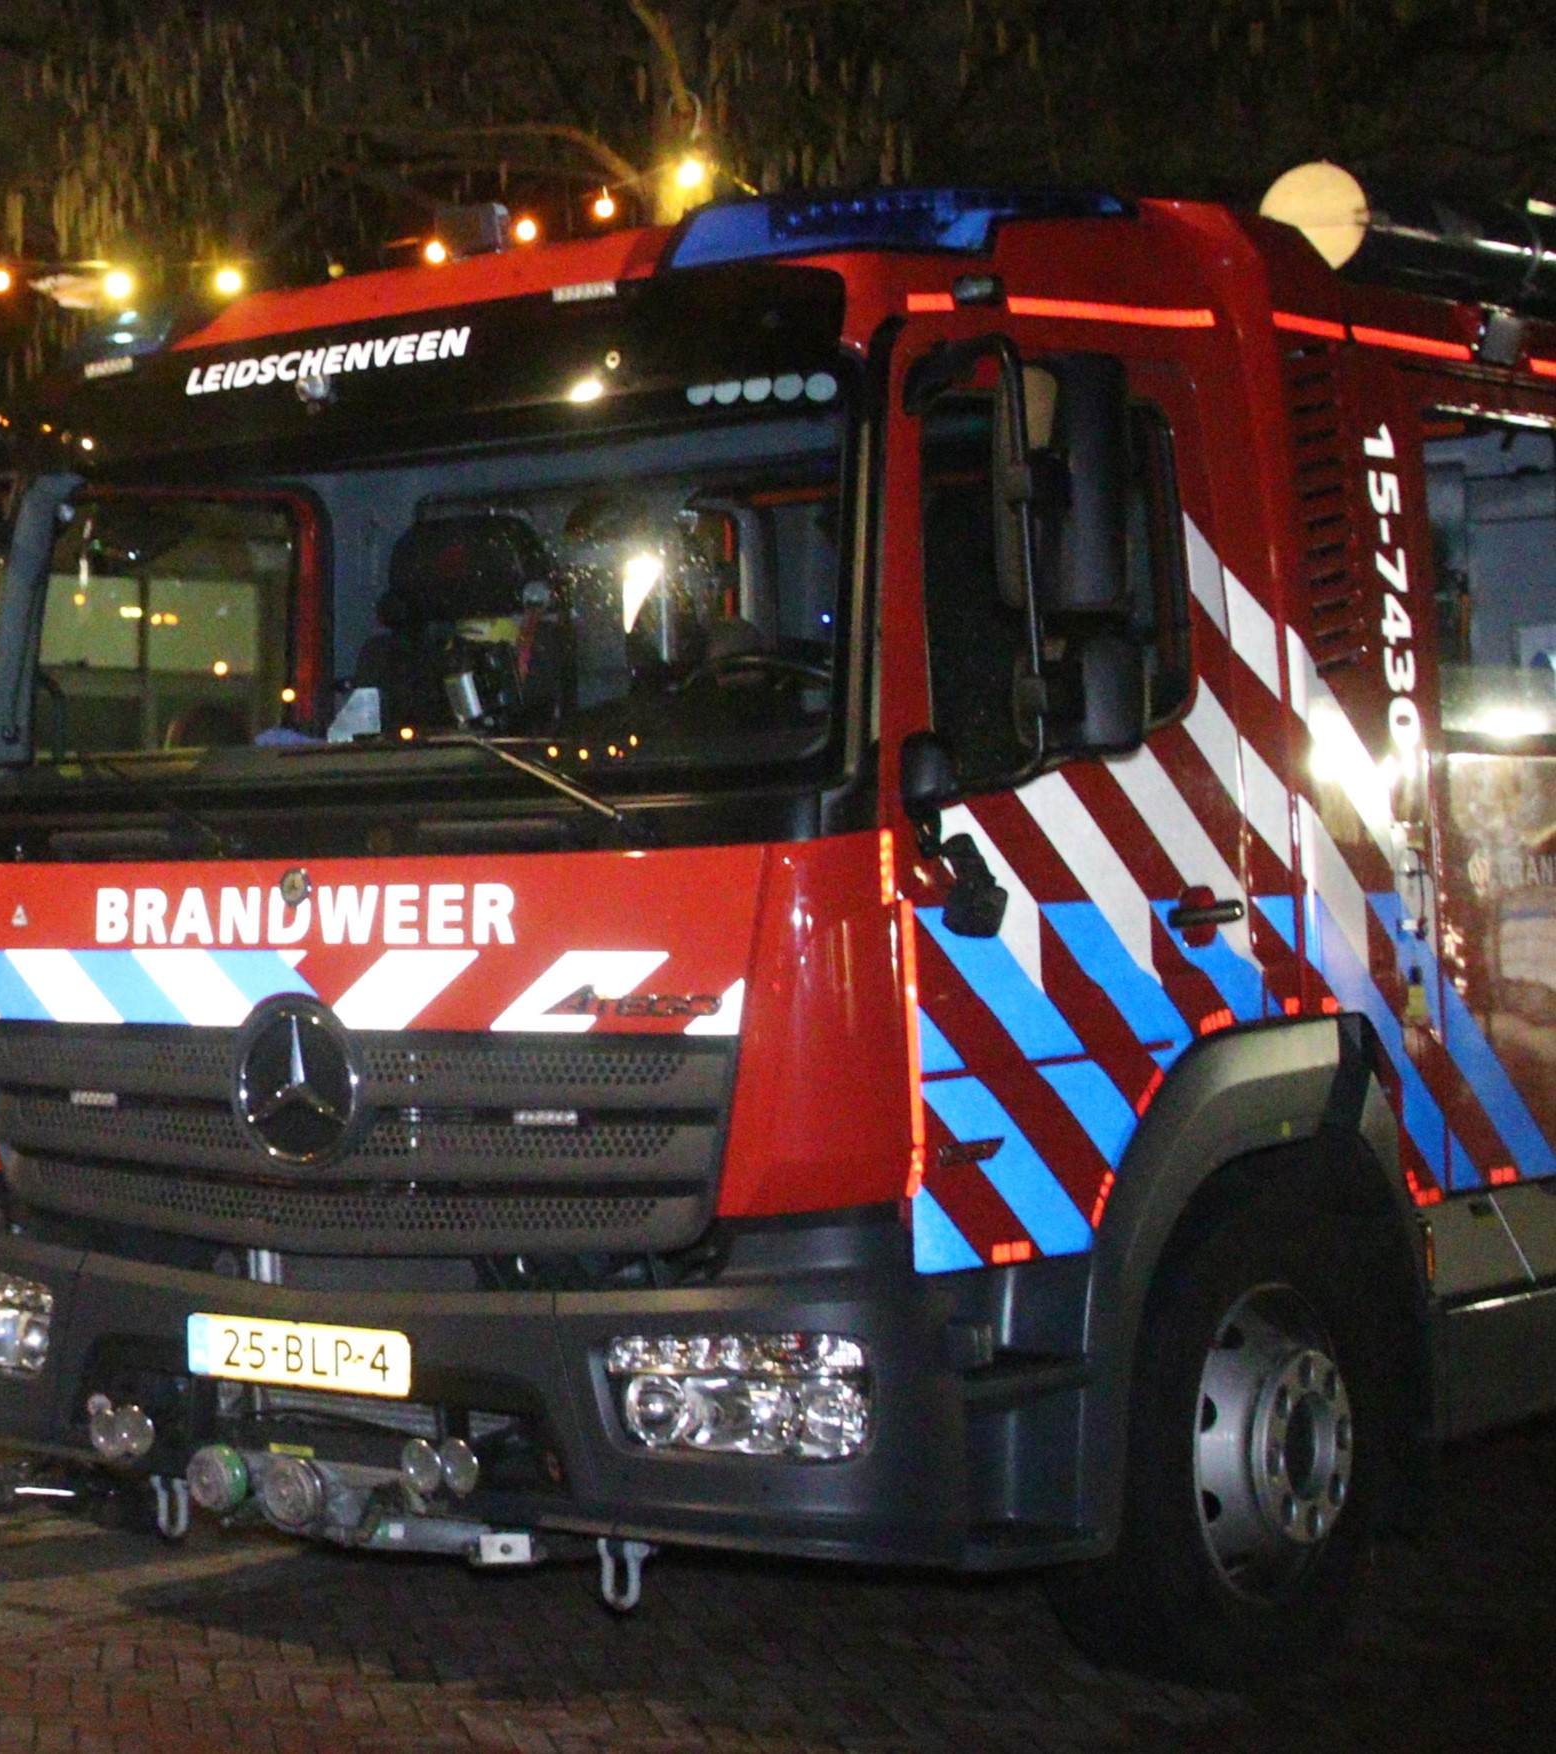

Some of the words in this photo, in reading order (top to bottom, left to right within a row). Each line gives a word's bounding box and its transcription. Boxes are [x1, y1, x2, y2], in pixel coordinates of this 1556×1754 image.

[185, 327, 471, 395] LEIDSCHENVEEN
[1363, 422, 1421, 750] 15-7430
[95, 883, 516, 944] BRANDWEER
[223, 1328, 390, 1383] 25-BLP-4
